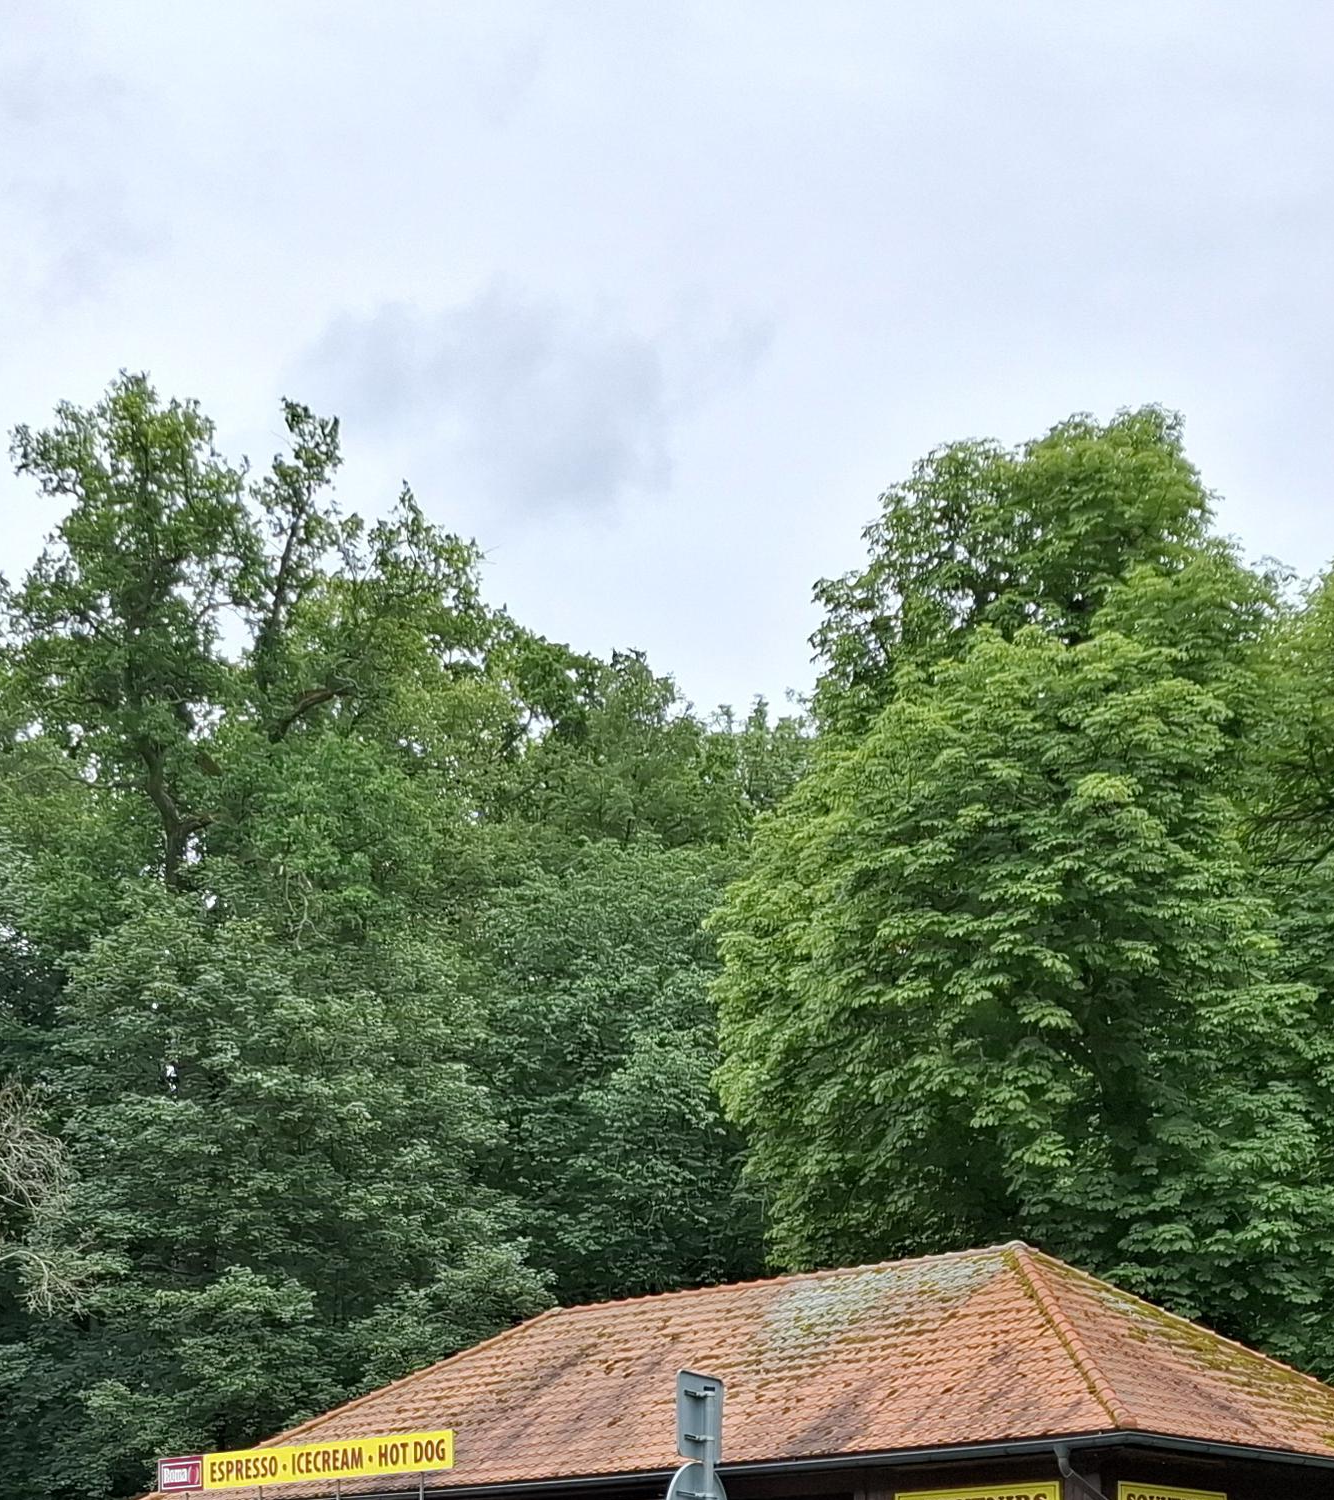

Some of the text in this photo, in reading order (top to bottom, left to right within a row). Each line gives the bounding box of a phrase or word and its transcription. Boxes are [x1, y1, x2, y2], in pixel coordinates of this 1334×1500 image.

[210, 1439, 446, 1483] ESPRESSO ICECREAM HOT DOG
